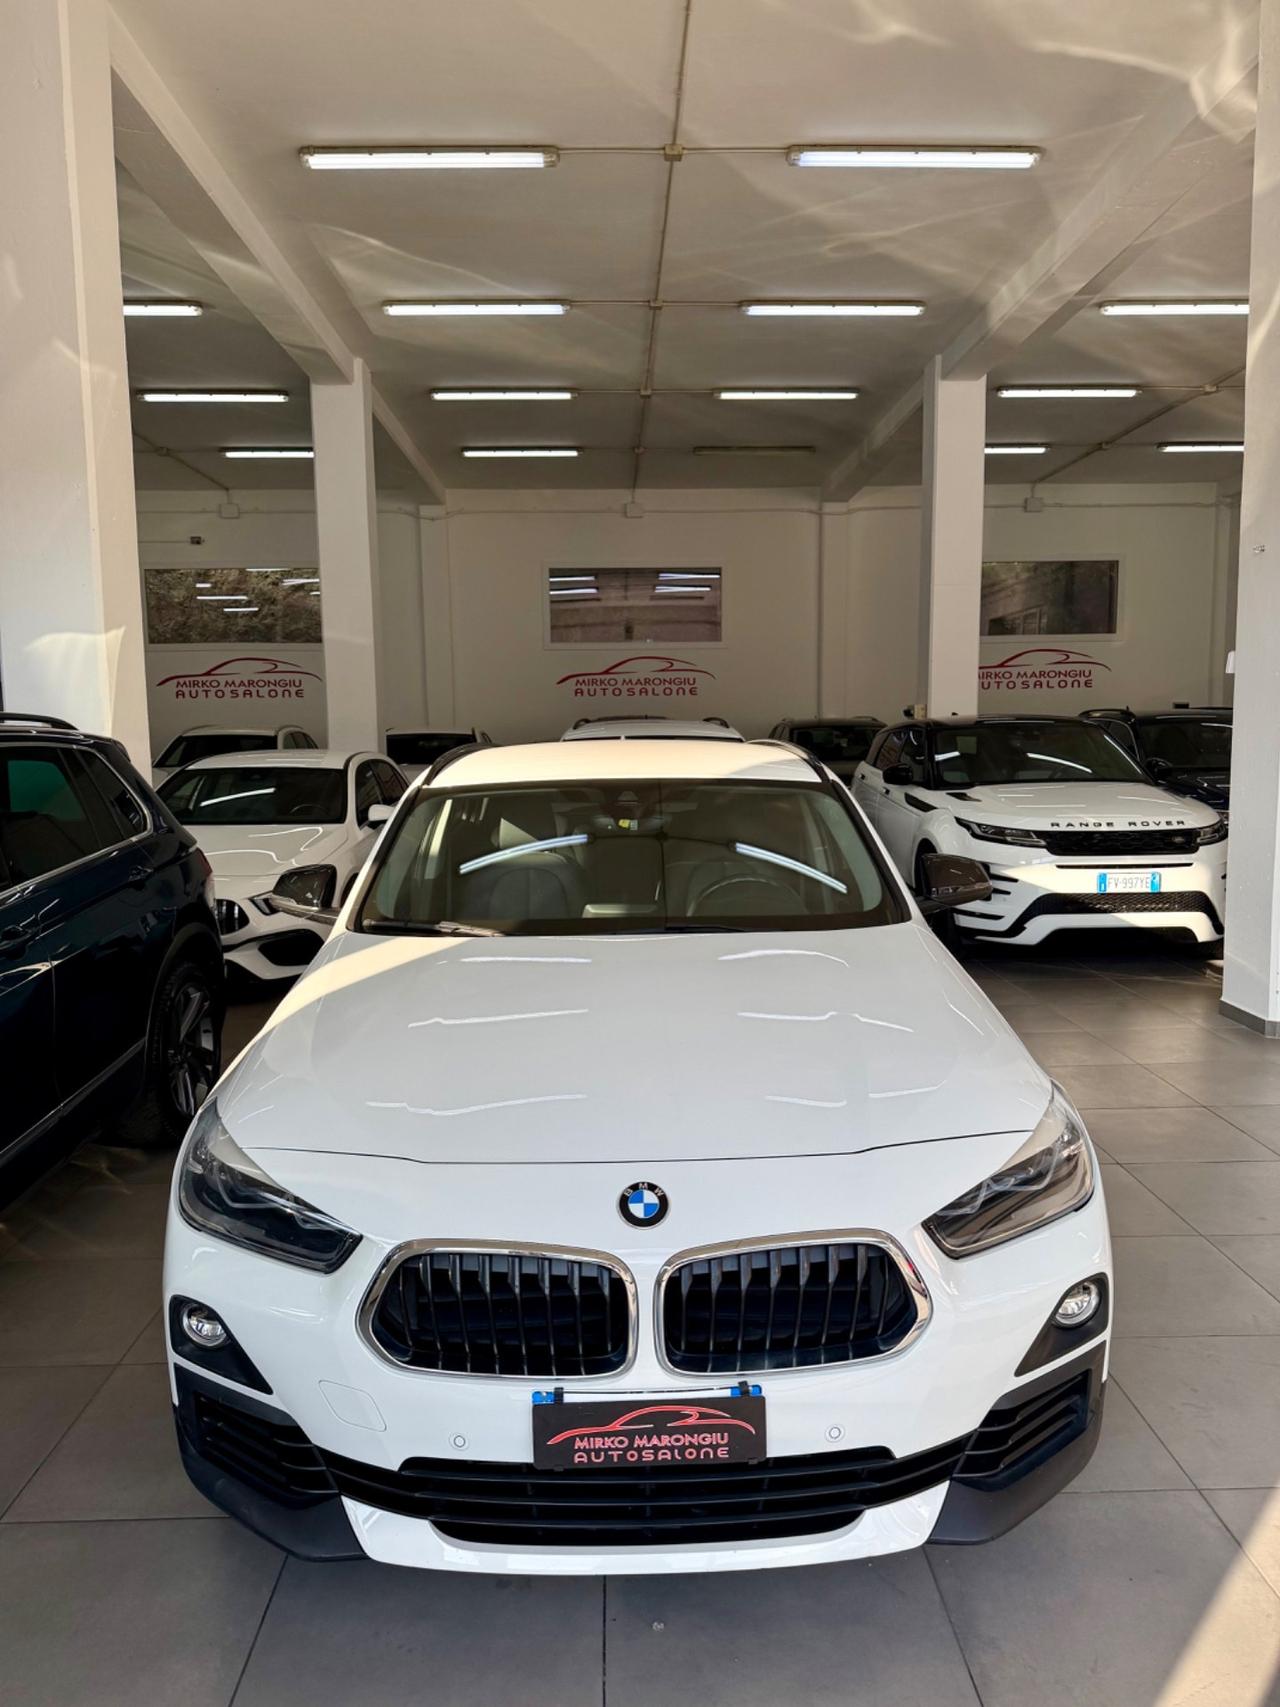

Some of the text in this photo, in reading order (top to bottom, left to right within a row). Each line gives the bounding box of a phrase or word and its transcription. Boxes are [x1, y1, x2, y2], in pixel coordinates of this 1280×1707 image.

[978, 669, 1092, 680] IRKO MARONGIU
[175, 679, 302, 689] MIRKO MARONGIU
[575, 677, 696, 687] MIRKO MARONGIU
[979, 679, 1093, 690] UTOSALONE
[175, 689, 305, 699] AUTOSALONE
[574, 687, 698, 697] AUTOSALONE
[623, 1182, 665, 1197] BMW
[573, 1432, 729, 1450] MIRKO MARONGIU
[573, 1446, 730, 1464] AUTOSALONE
